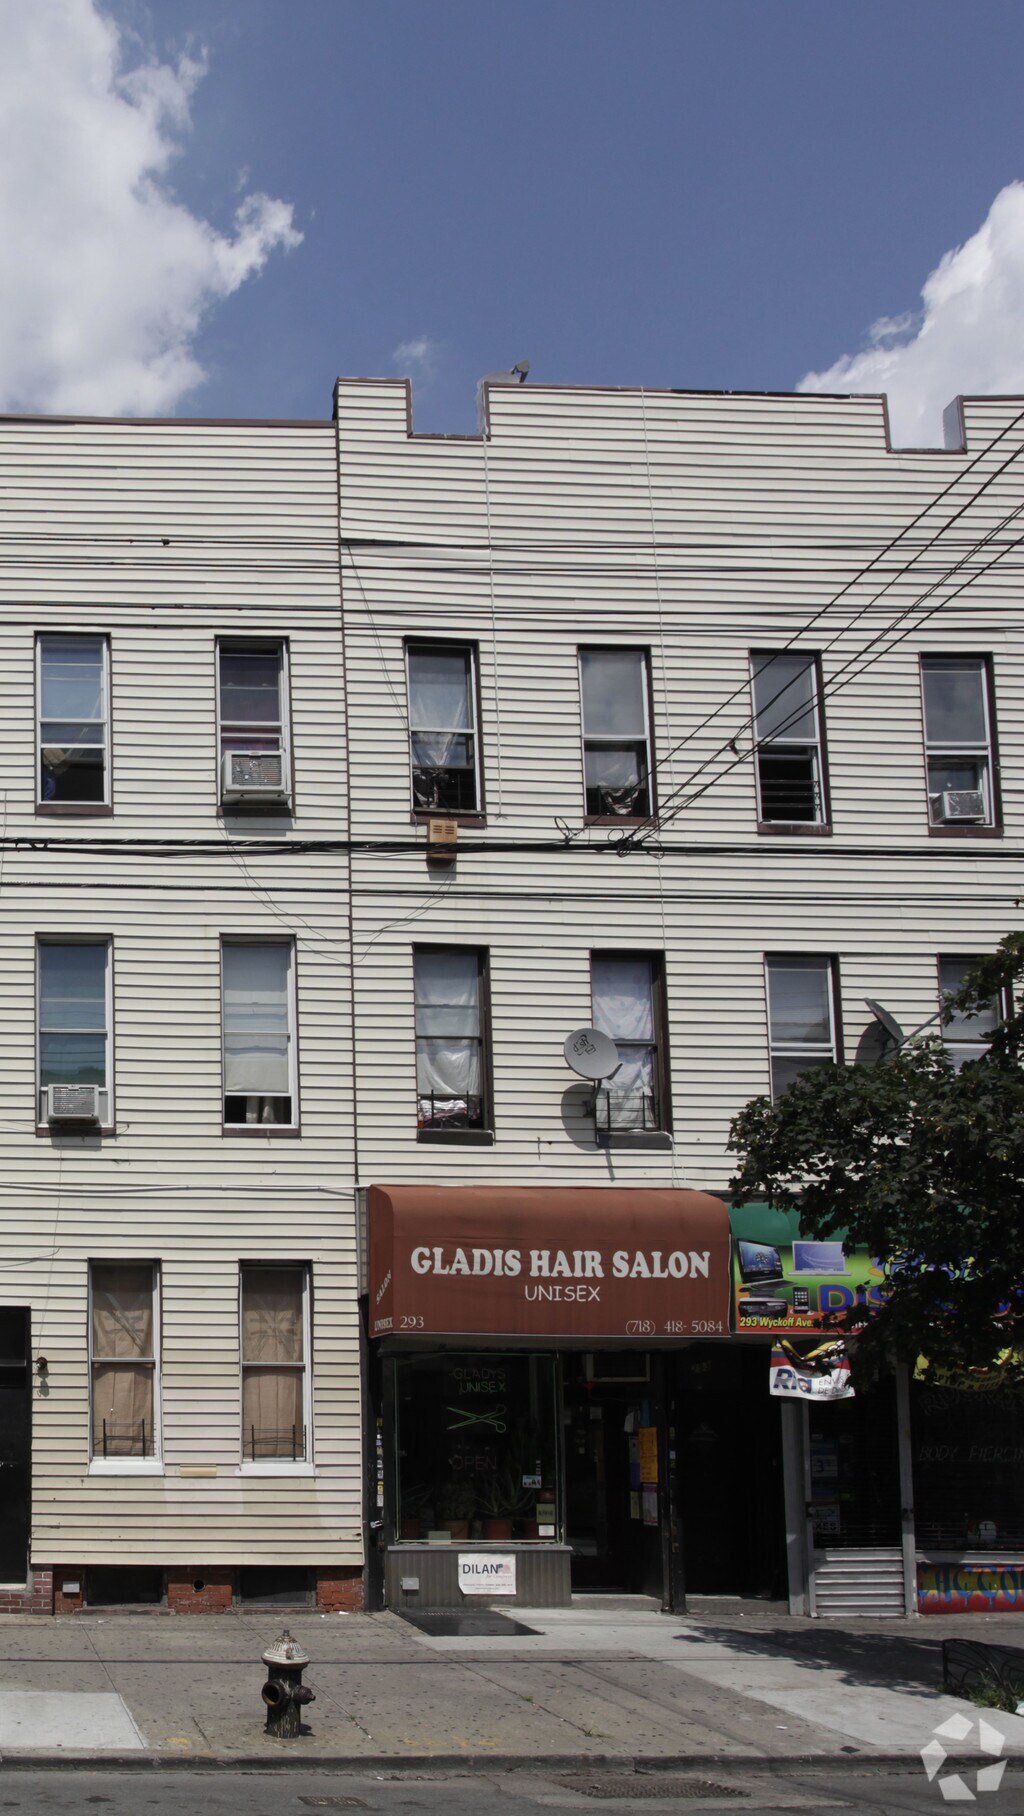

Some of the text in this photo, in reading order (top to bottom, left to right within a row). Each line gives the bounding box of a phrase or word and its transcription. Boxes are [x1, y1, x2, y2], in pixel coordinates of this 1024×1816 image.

[410, 1247, 711, 1279] GLADIS HAIR SALON
[524, 1285, 601, 1302] UNISEX
[400, 1316, 425, 1329] 293
[625, 1320, 656, 1335] (718)
[691, 1320, 723, 1333] 5084
[740, 1317, 758, 1327] 293
[759, 1316, 794, 1328] Wyckoff
[453, 1367, 506, 1381] GLADYS
[460, 1381, 506, 1393] UNISEX
[919, 1445, 959, 1462] BODY
[450, 1455, 497, 1472] OPEN
[462, 1563, 499, 1575] DILAN
